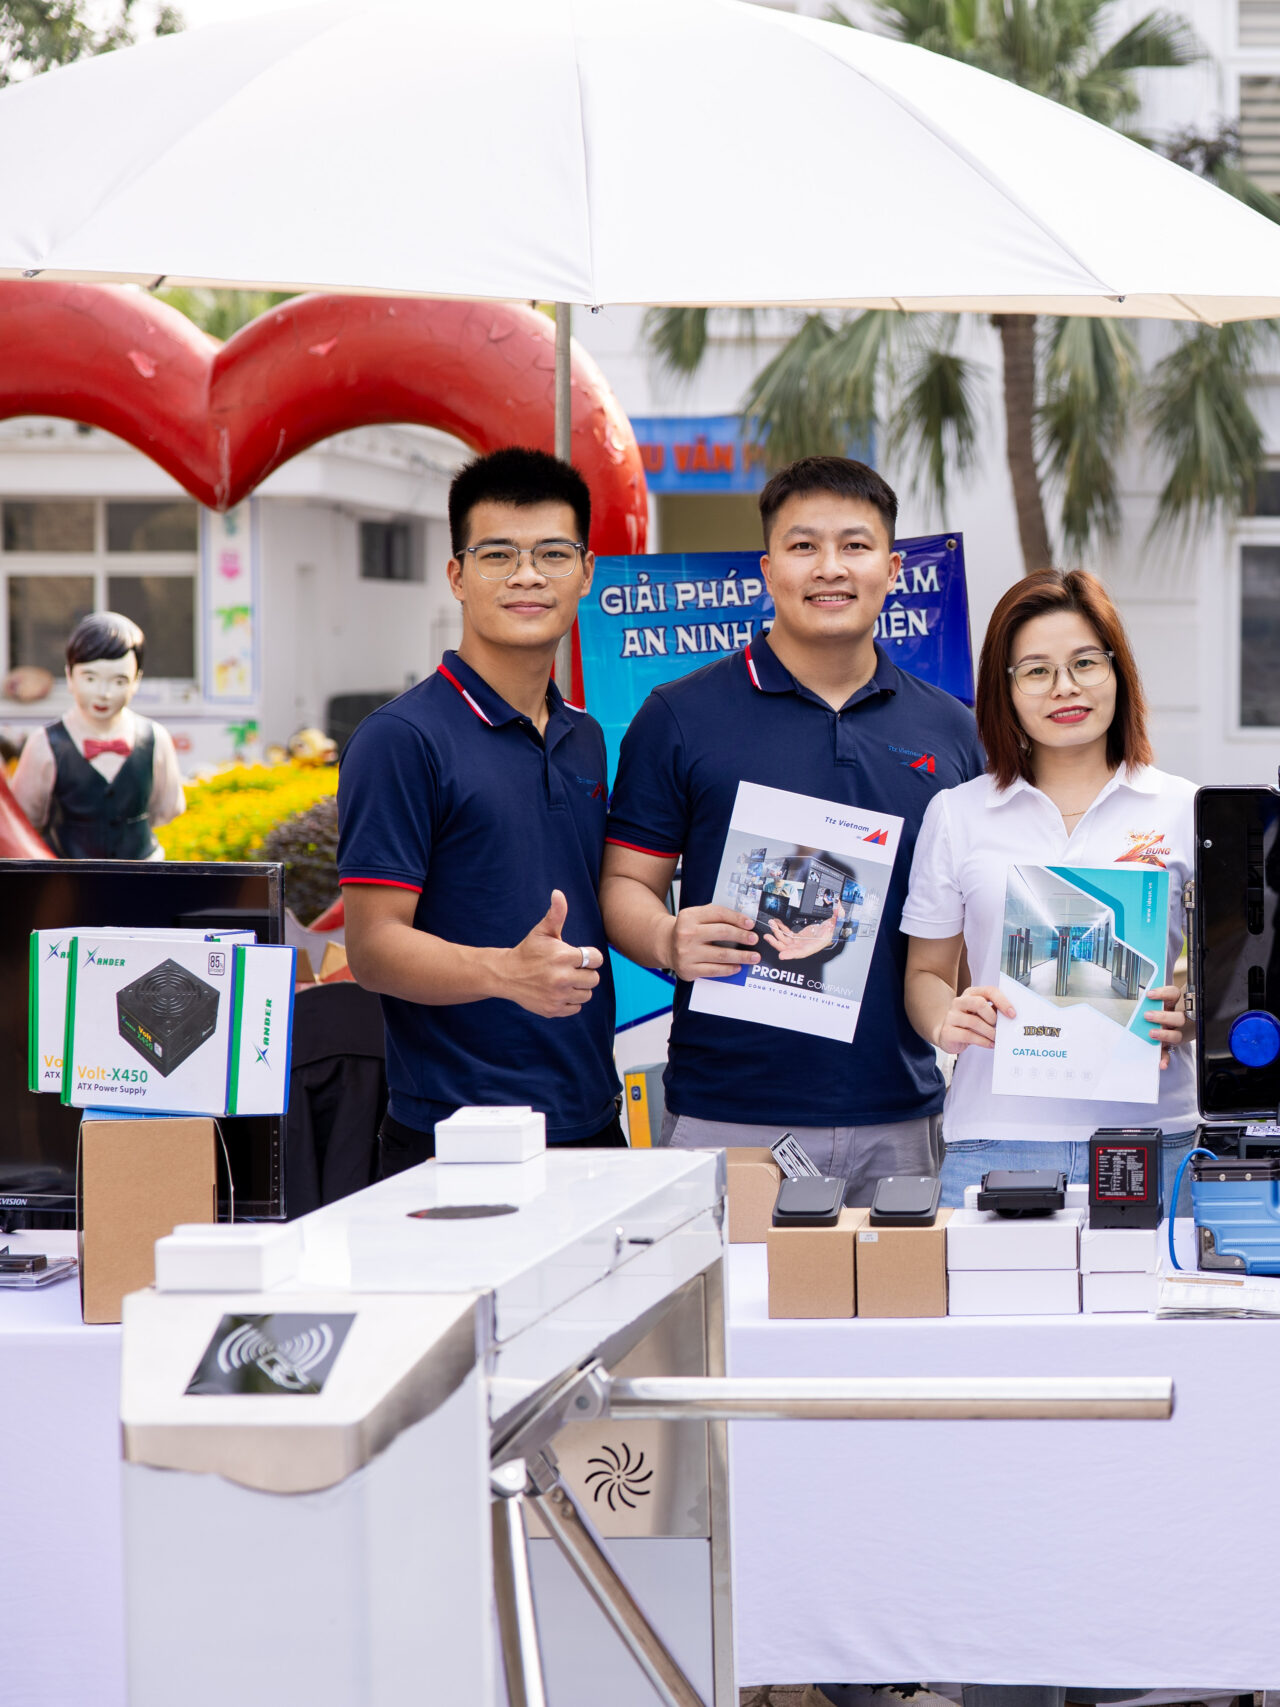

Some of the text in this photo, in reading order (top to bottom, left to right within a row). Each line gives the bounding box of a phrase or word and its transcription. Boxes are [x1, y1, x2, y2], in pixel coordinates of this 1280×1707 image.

[601, 573, 666, 615] GIẢI
[676, 569, 762, 611] PHÁP
[621, 600, 929, 657] AN NINH IỆN
[825, 816, 869, 832] Ttz Vietnam
[751, 965, 854, 997] PROFILE COMPANY
[1024, 1025, 1061, 1037] IDSUN
[1012, 1048, 1068, 1058] CATALOGUE
[44, 1071, 61, 1079] ATX
[77, 1066, 148, 1083] Volt-X450
[94, 1084, 118, 1093] Power
[119, 1085, 147, 1096] Supply
[0, 1198, 27, 1206] VISION
